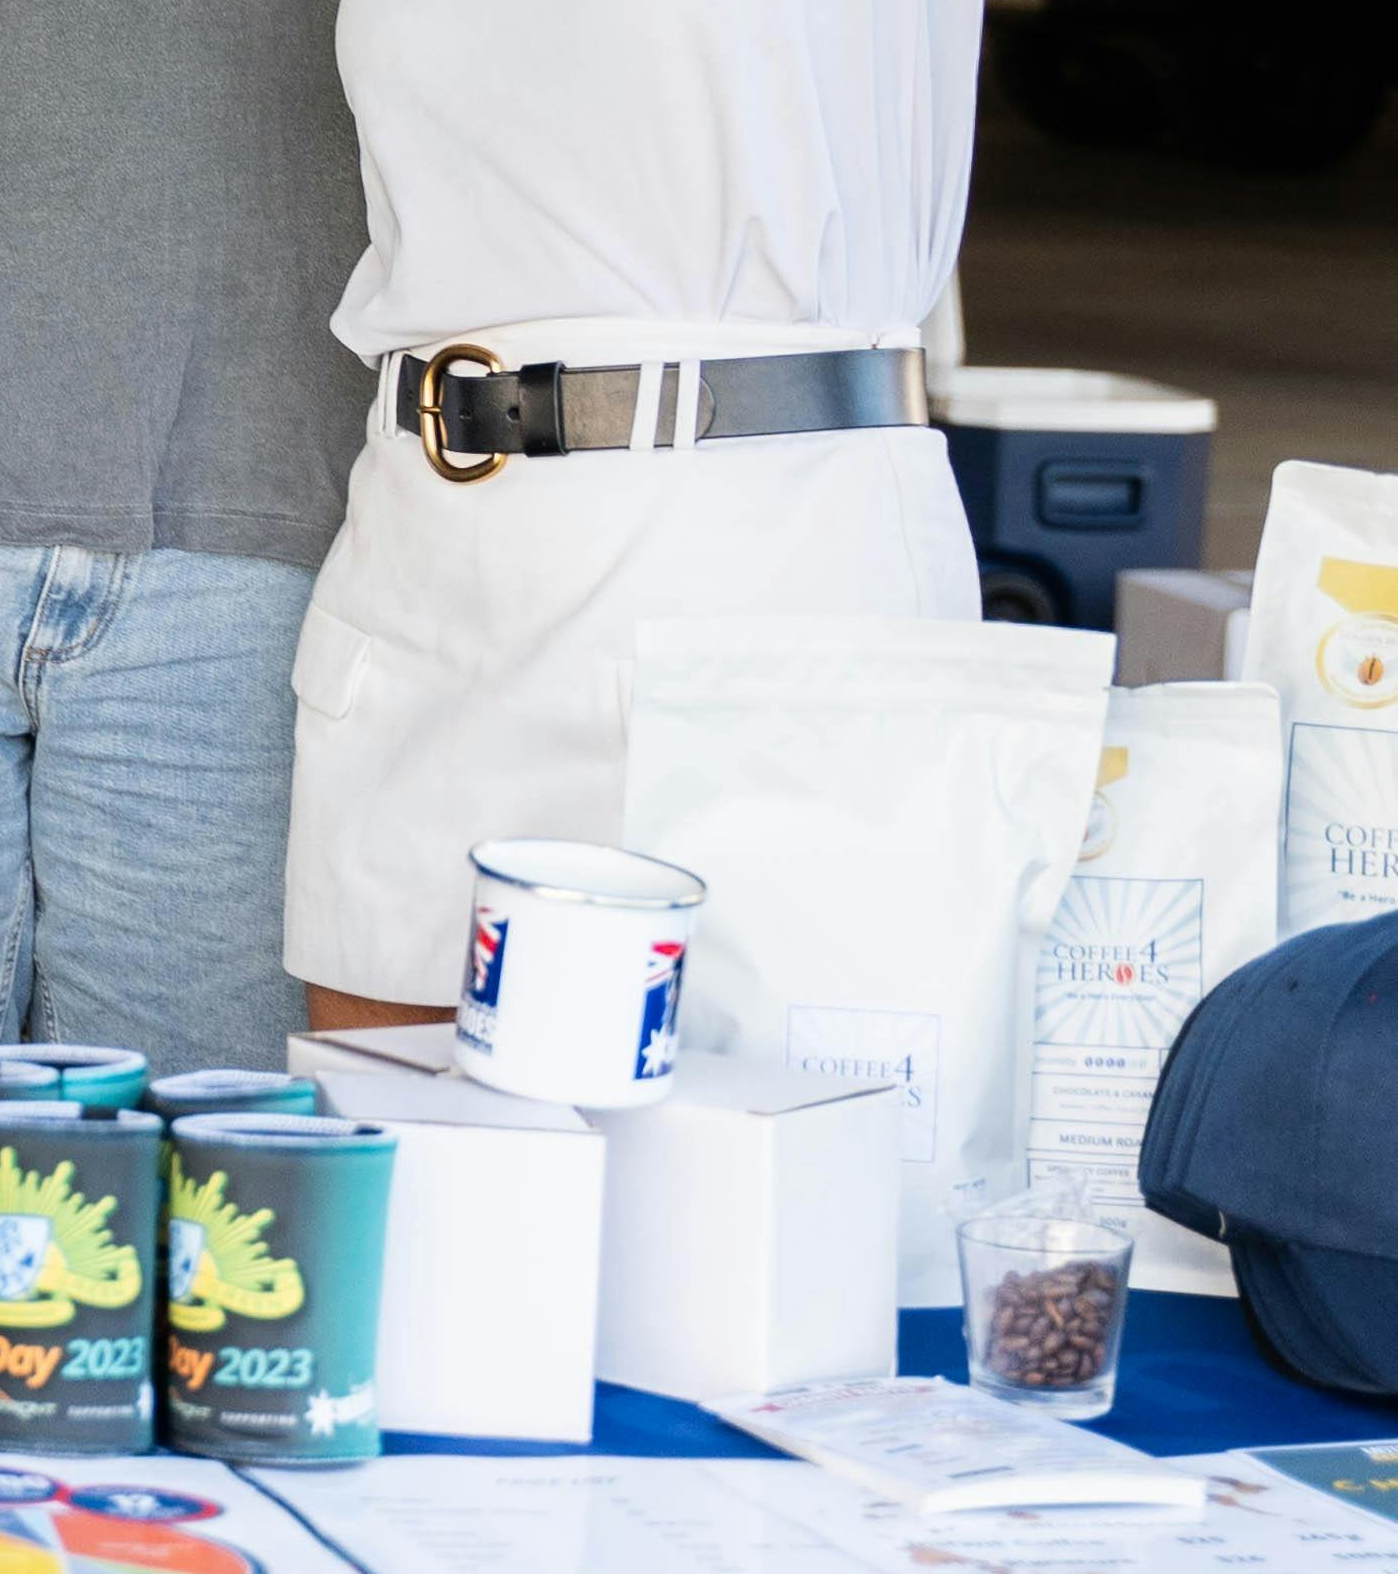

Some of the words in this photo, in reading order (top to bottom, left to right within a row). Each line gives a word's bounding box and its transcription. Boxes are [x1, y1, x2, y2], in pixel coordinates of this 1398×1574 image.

[1324, 820, 1398, 850] COFF
[1330, 846, 1398, 879] HER
[1052, 943, 1137, 962] COFFEE
[1138, 938, 1158, 964] 4
[802, 1055, 892, 1079] COFFEE
[893, 1053, 915, 1083] 4
[1058, 1133, 1113, 1147] MEDIUM
[1115, 1135, 1142, 1148] ROA
[61, 1335, 147, 1382] 2023
[168, 1334, 215, 1391] ay
[214, 1346, 313, 1389] 2023
